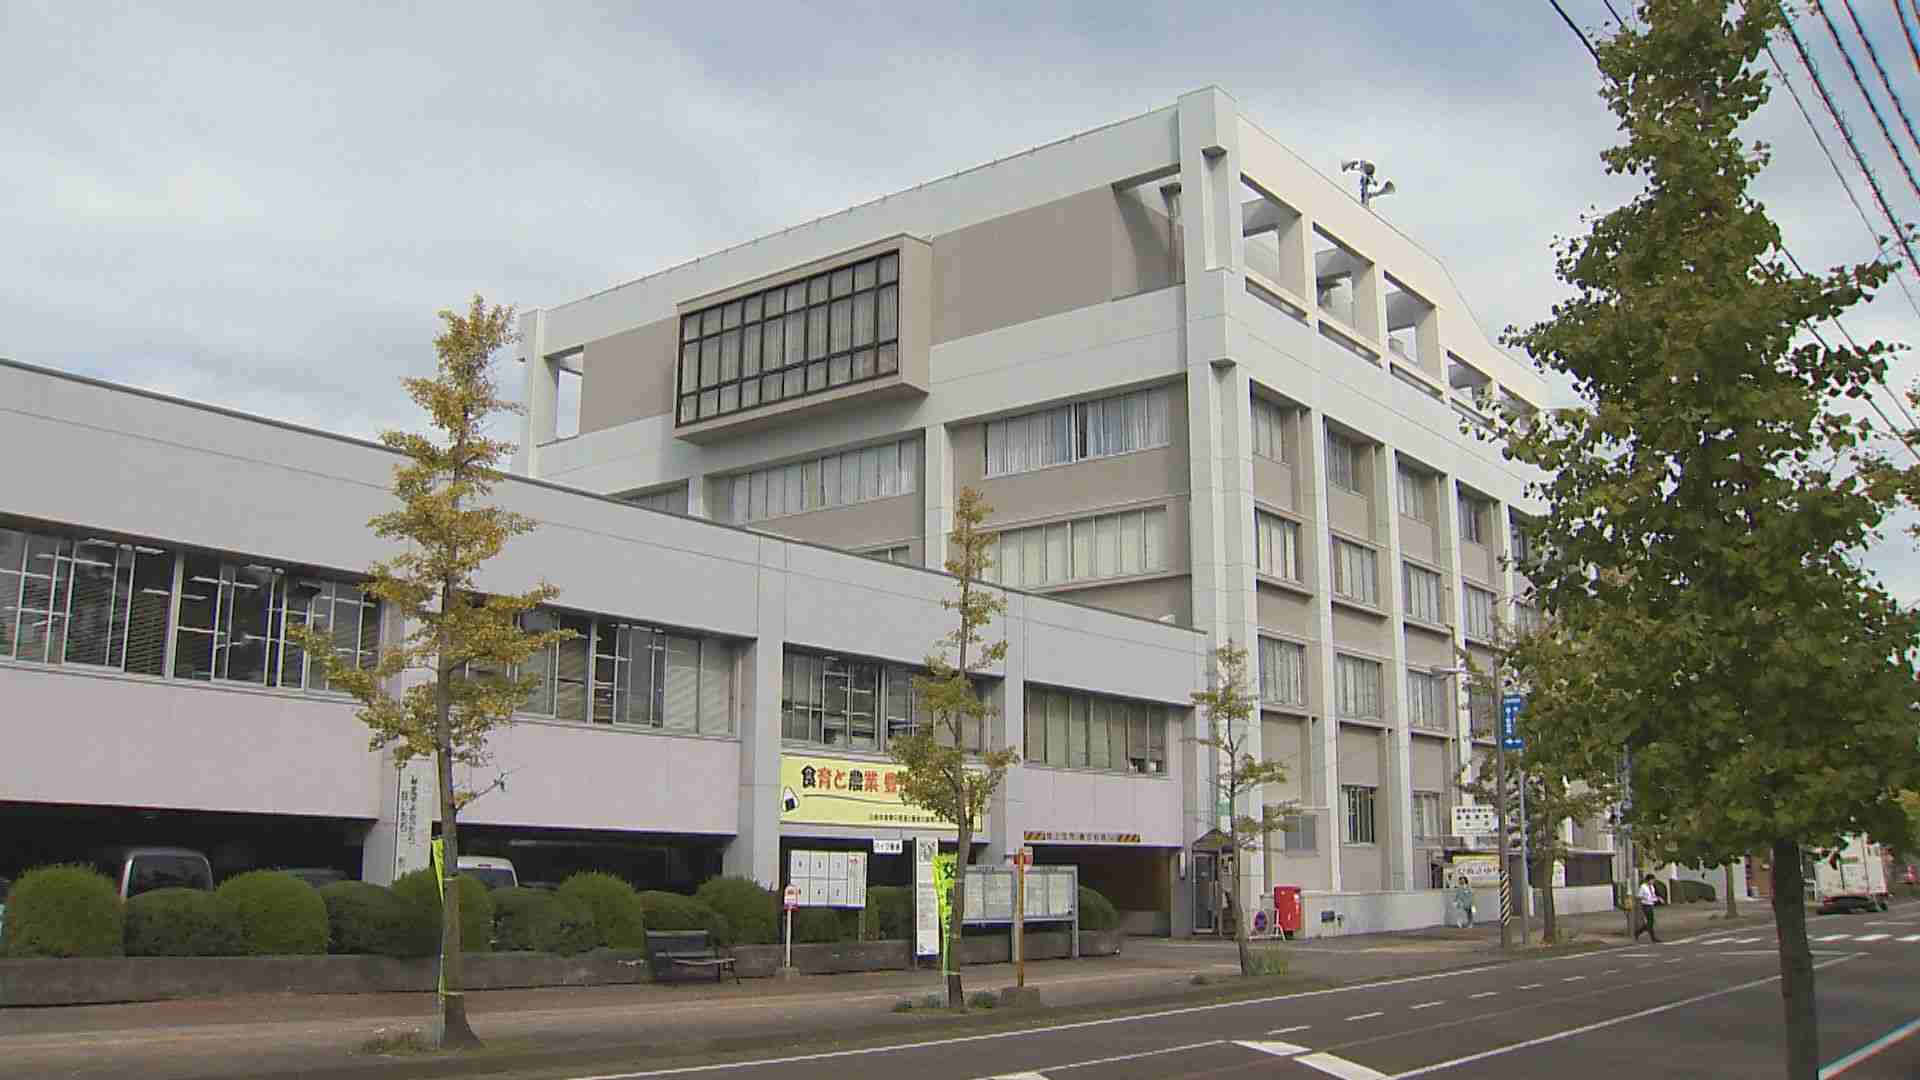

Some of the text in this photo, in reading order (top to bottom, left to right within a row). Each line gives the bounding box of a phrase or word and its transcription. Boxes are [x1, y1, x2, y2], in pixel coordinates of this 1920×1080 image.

[801, 765, 879, 793] 食育と農業
